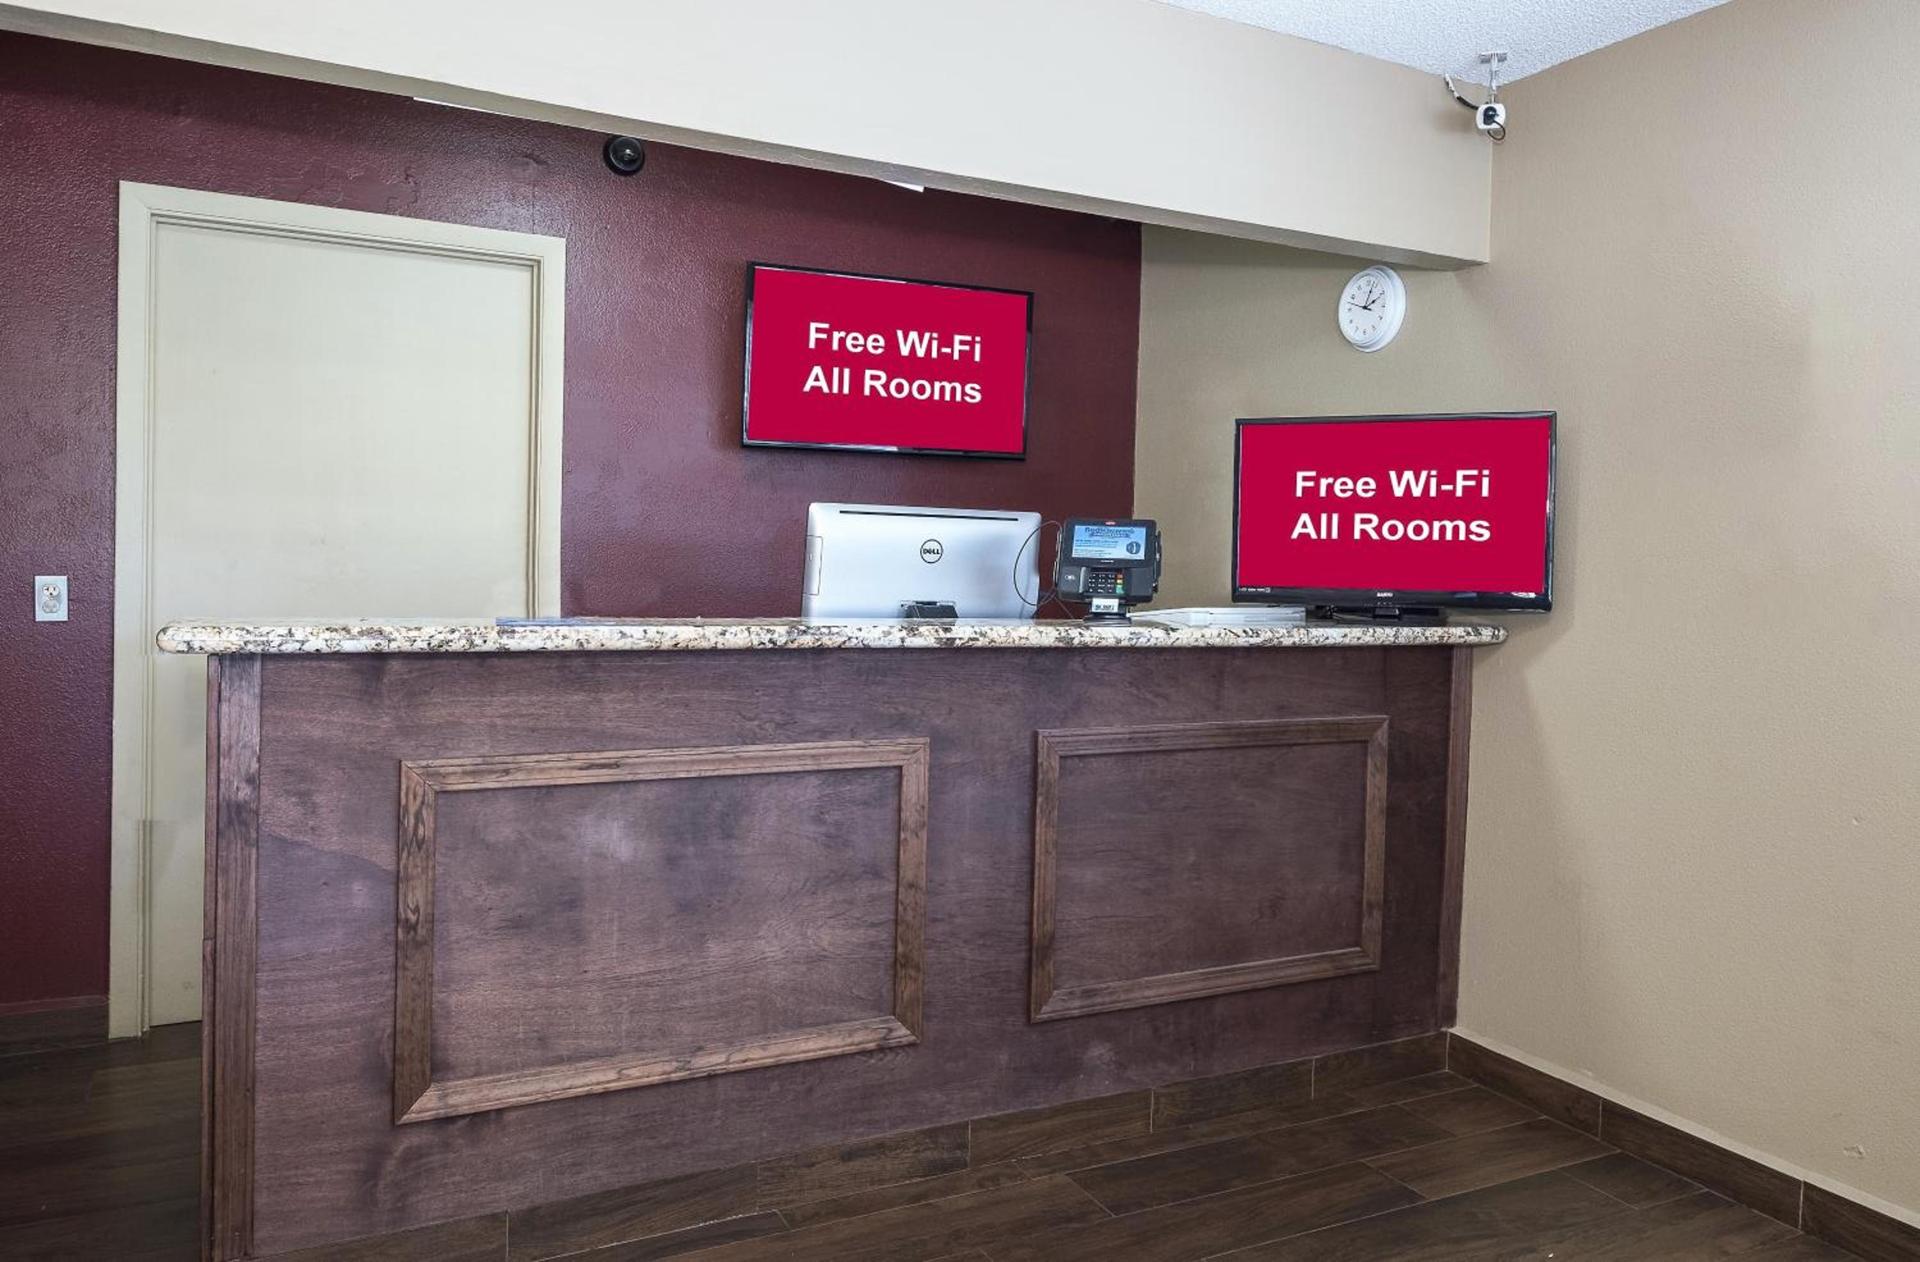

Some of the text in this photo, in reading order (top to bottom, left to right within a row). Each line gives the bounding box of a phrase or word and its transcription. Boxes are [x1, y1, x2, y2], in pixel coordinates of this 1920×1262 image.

[808, 321, 982, 363] Free Wi-Fi
[802, 365, 983, 404] All Rooms
[1295, 469, 1490, 498] Free Wi-Fi
[1290, 512, 1492, 542] All Rooms
